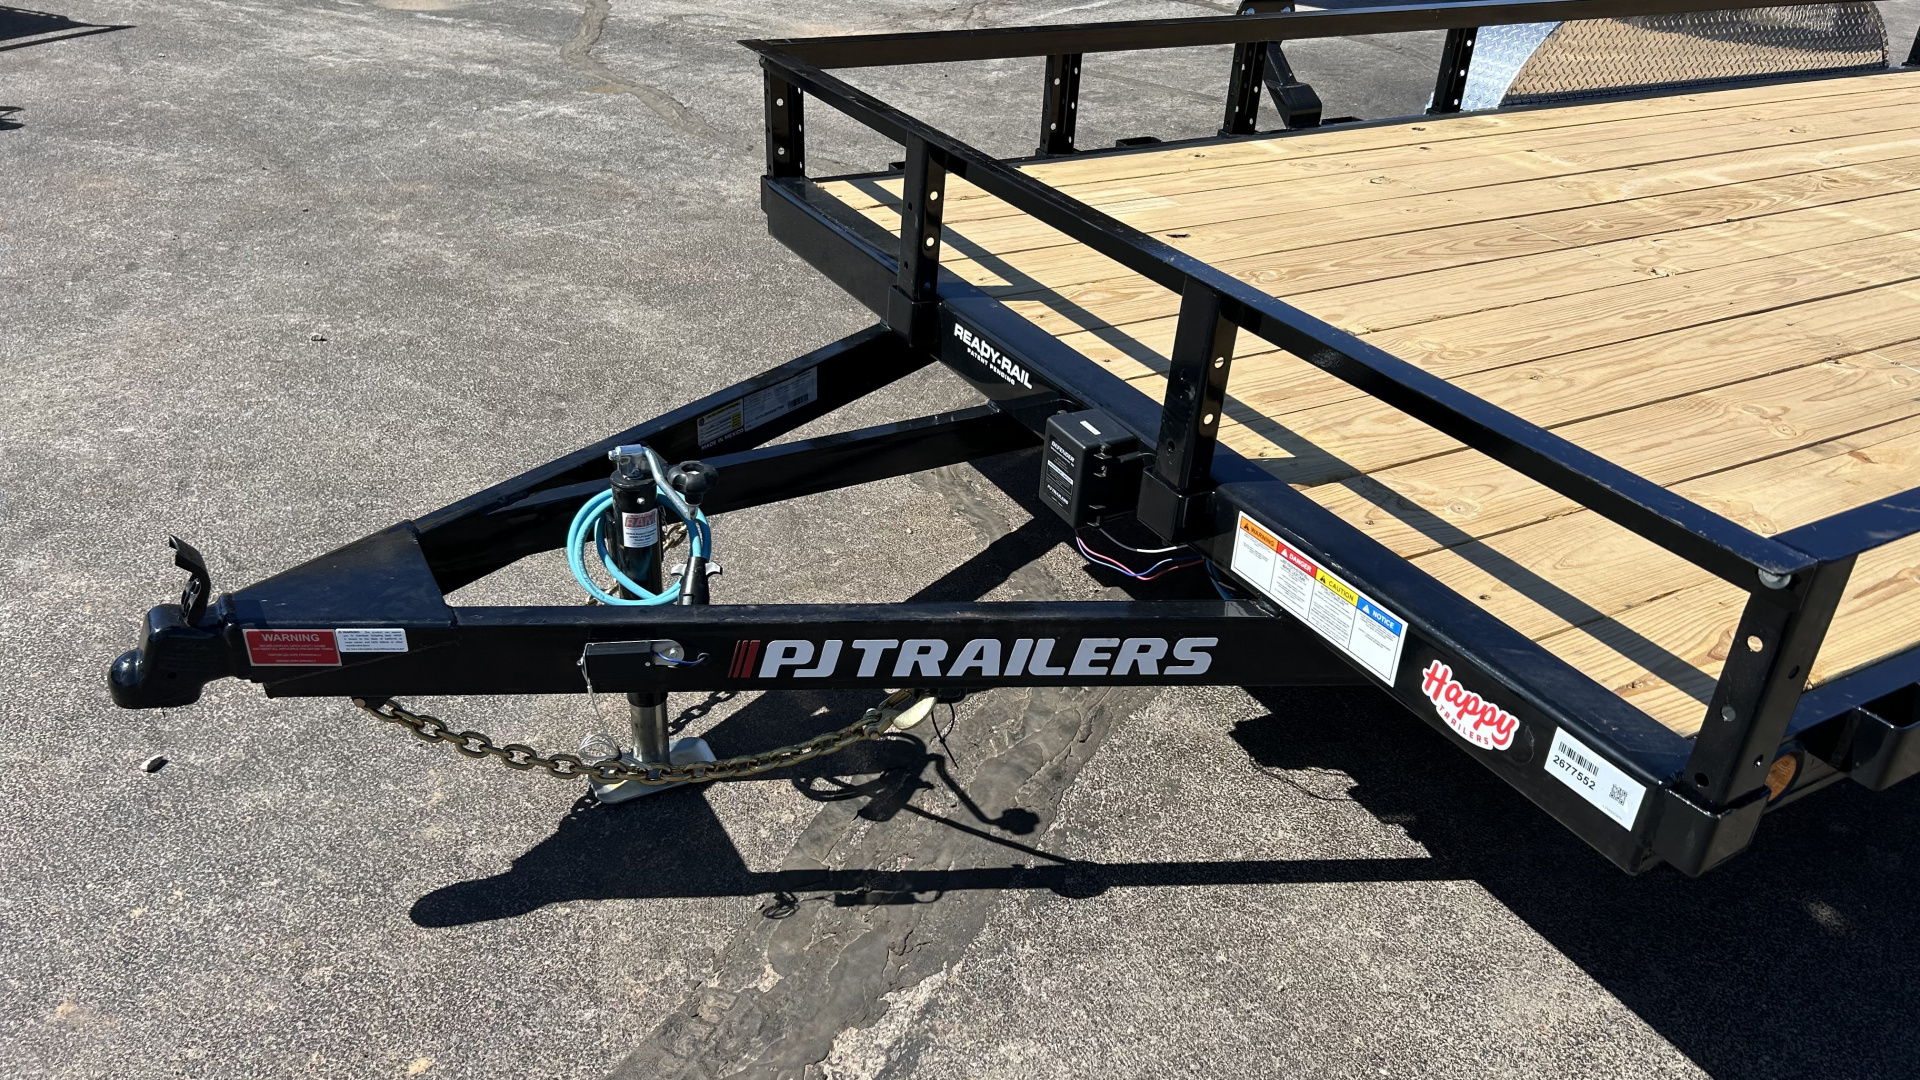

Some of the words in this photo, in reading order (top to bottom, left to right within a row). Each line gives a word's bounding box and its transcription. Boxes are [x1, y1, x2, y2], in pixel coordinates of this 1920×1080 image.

[967, 347, 988, 366] PATENT
[989, 364, 1016, 386] PENDING
[701, 440, 717, 451] MADE
[724, 427, 744, 440] MEXICO
[1051, 440, 1075, 462] DEFENDER
[626, 513, 656, 527] RAM
[1250, 527, 1275, 547] WARNING
[1289, 553, 1312, 573] DANGER
[1328, 580, 1354, 601] CAUTION
[1372, 610, 1395, 629] NOTICE
[261, 633, 320, 642] WARNING
[758, 639, 841, 678] PJ
[851, 637, 1220, 677] TRAILERS
[1425, 662, 1516, 747] Happy
[1438, 704, 1490, 746] TRAILERS
[1552, 754, 1596, 791] 2677552
